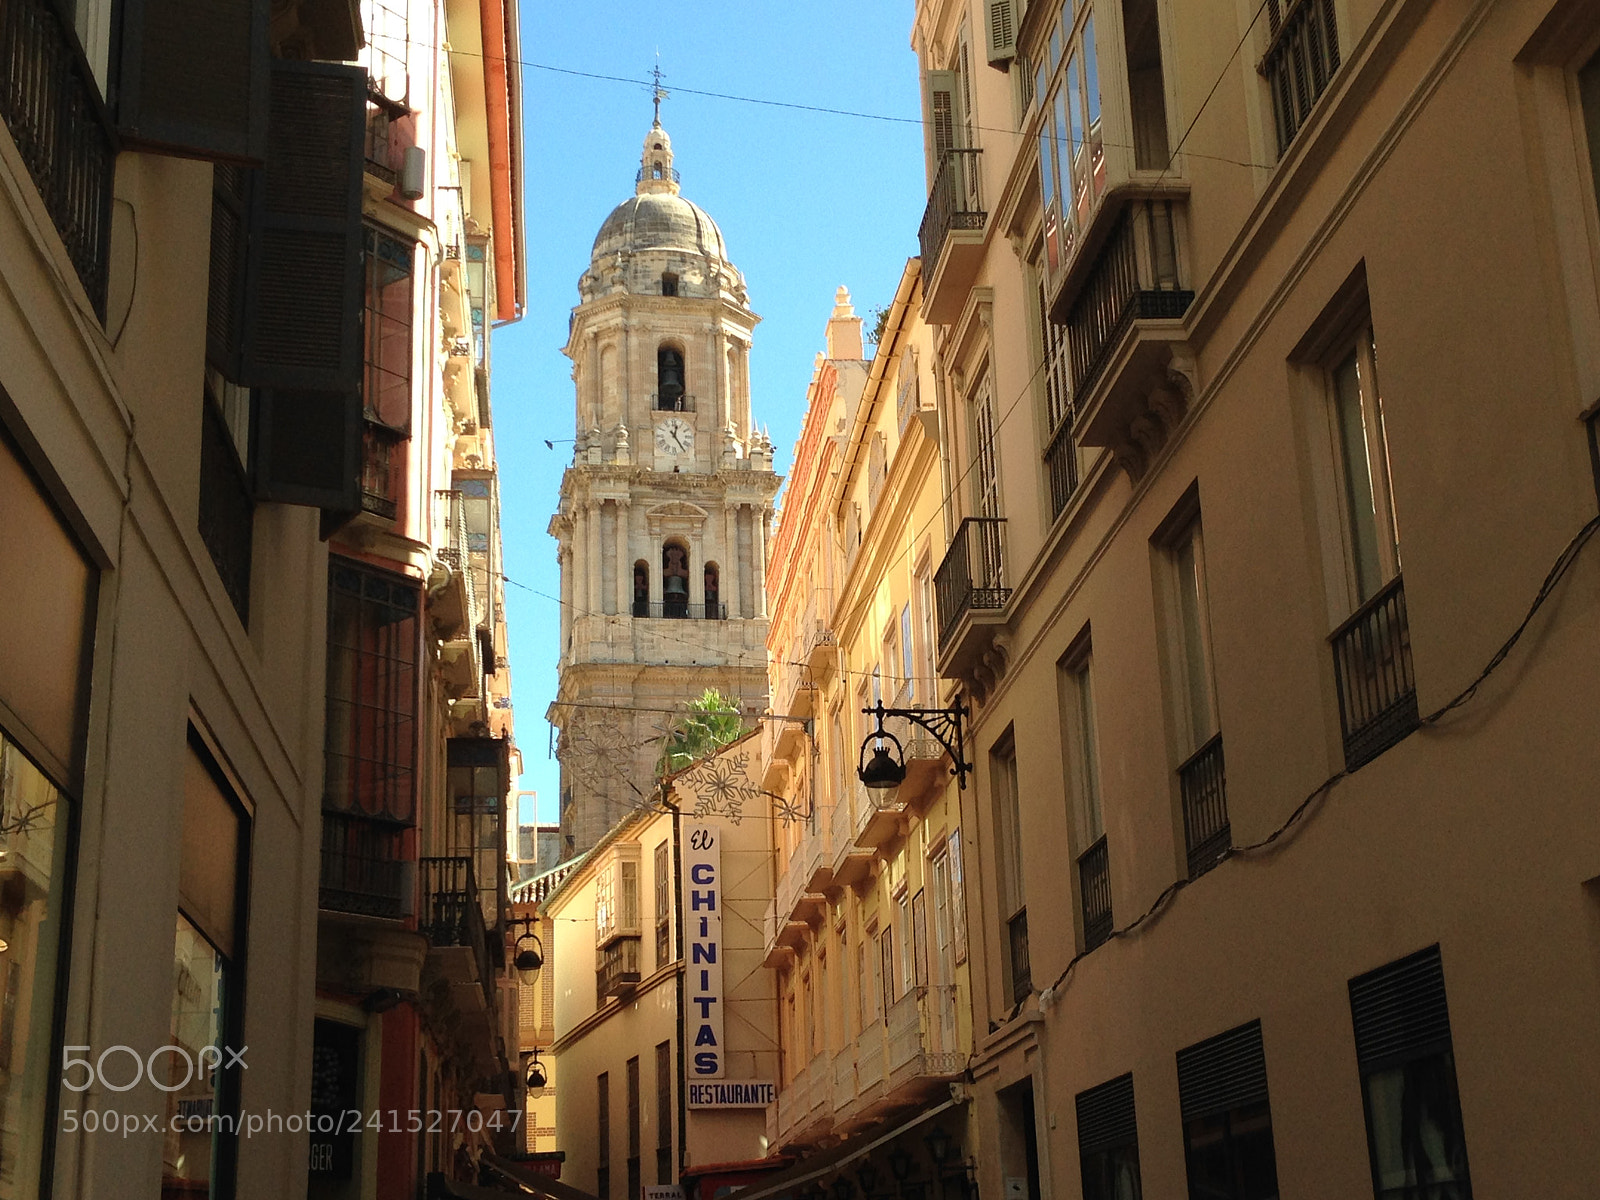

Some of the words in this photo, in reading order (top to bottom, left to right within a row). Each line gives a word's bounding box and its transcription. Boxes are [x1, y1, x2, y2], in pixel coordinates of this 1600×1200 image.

[690, 829, 714, 850] El
[691, 863, 719, 1075] CHINITAS
[689, 1084, 774, 1105] RESTAURANTE
[309, 1143, 333, 1171] GER
